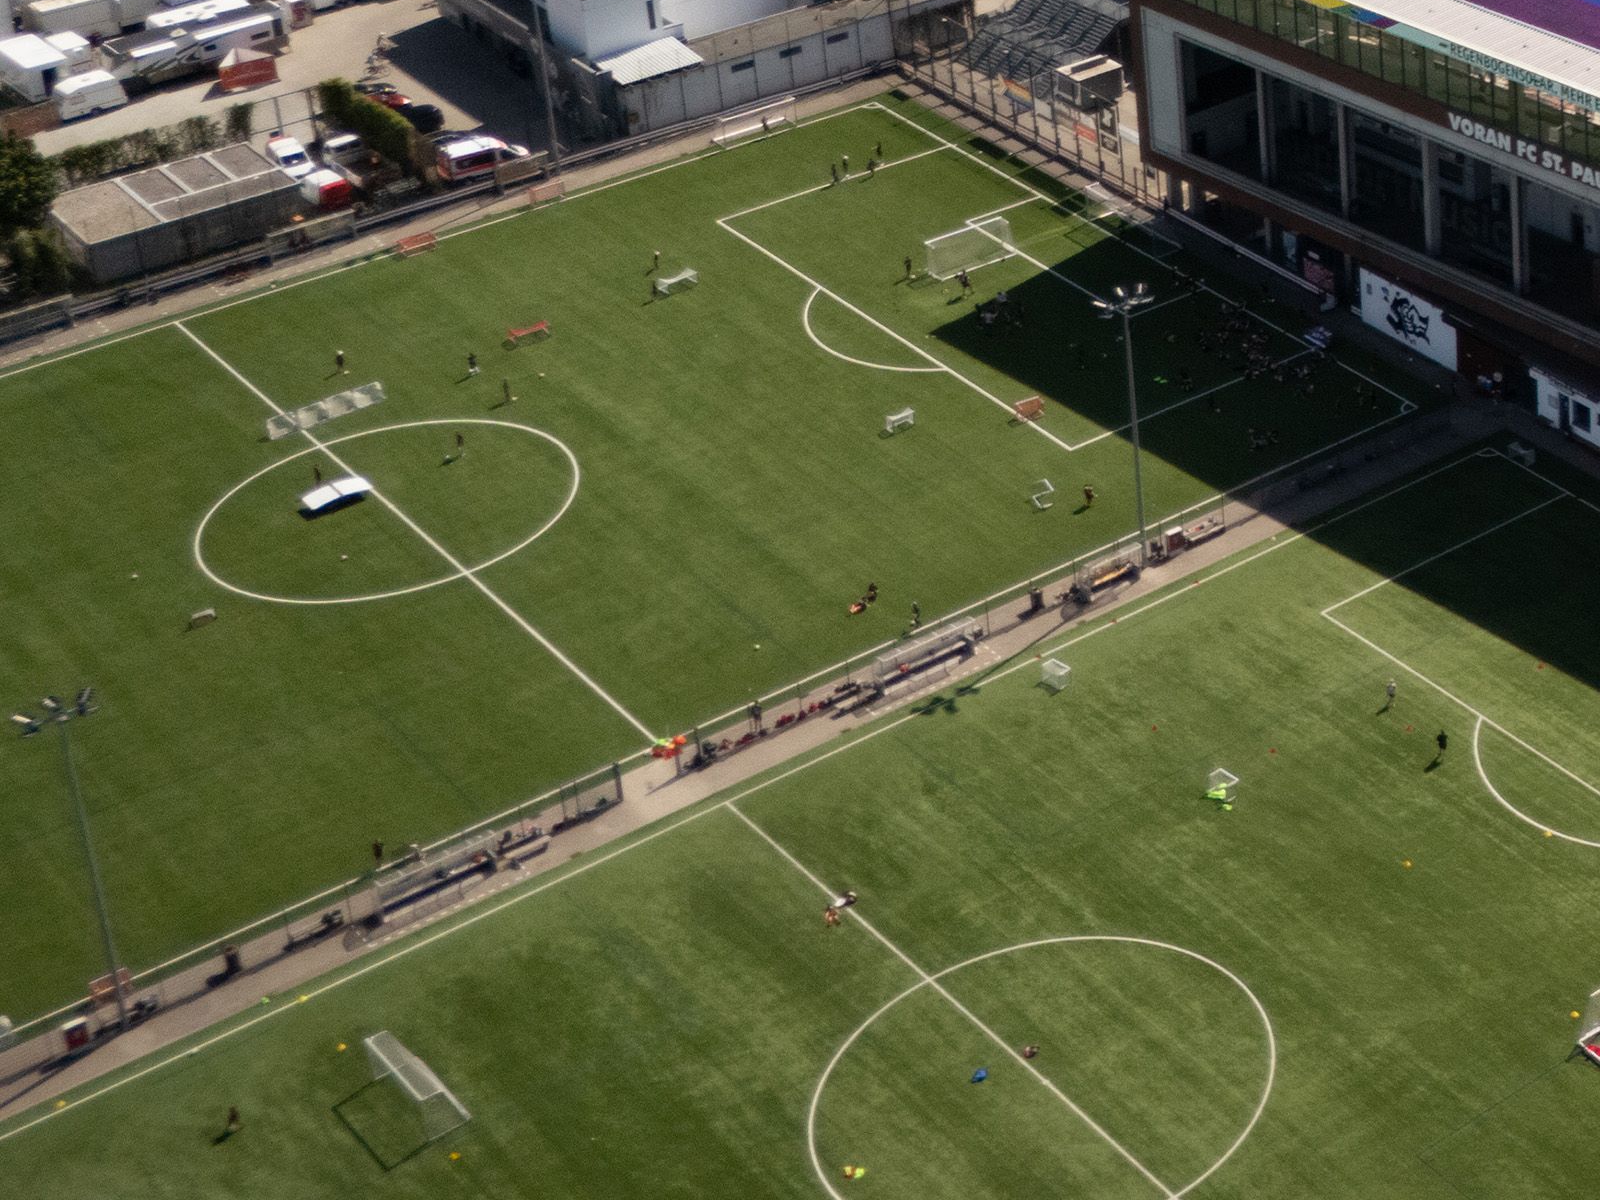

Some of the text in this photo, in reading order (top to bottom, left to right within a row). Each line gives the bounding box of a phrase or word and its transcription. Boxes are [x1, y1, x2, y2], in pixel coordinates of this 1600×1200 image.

[1560, 85, 1594, 109] MEHR
[1449, 112, 1512, 153] VORAN
[1516, 139, 1538, 164] FC
[1541, 150, 1566, 175] ST.
